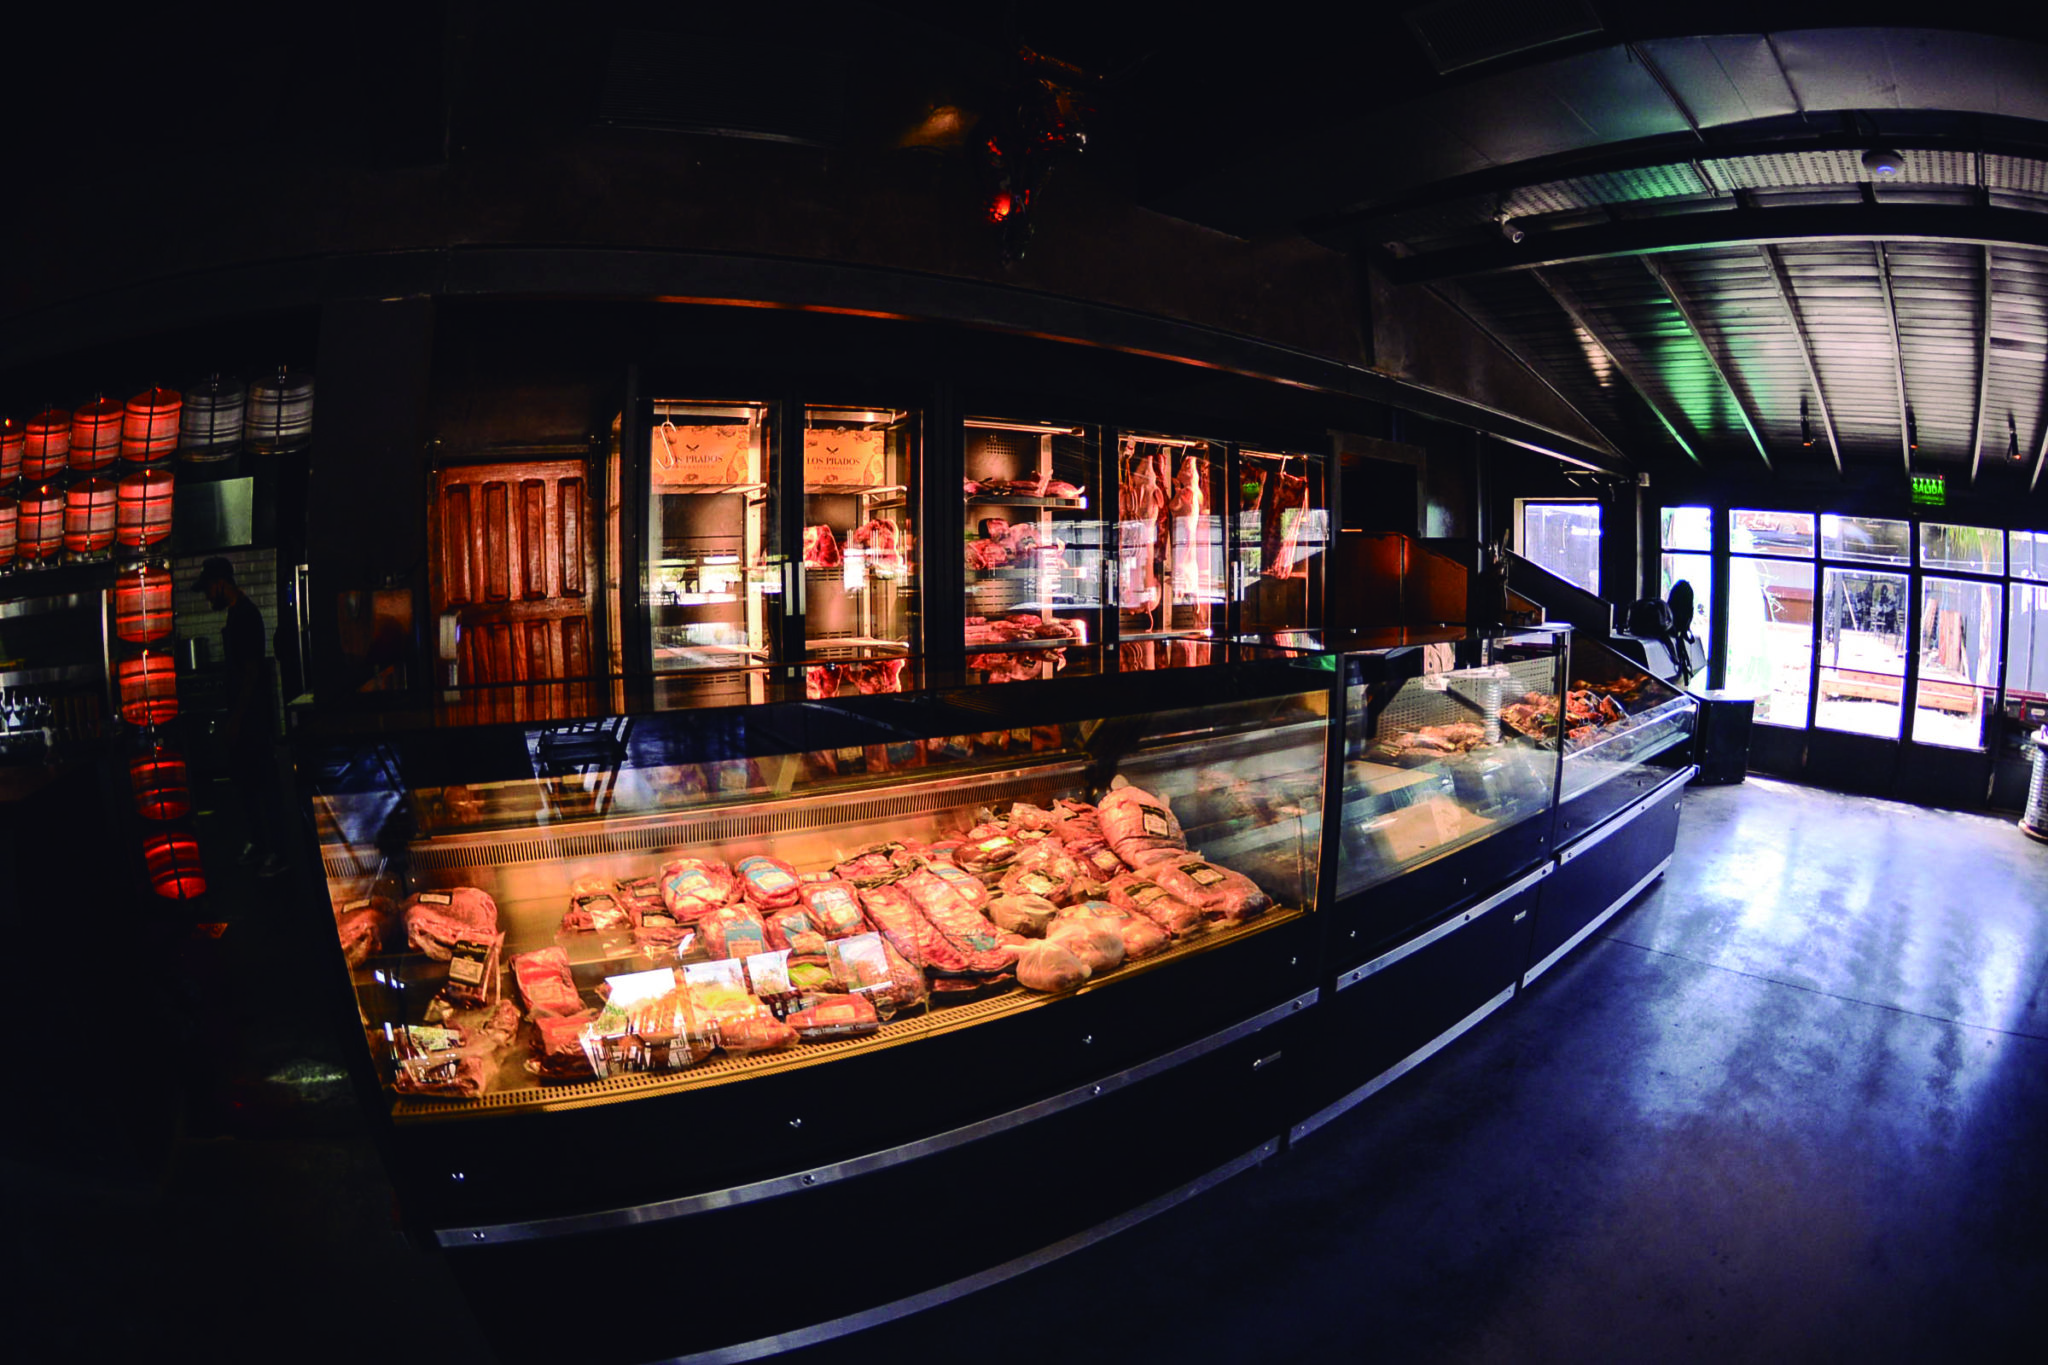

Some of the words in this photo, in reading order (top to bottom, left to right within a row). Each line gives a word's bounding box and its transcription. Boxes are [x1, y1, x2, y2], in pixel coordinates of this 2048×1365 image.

[686, 455, 723, 464] PRADOS
[806, 456, 824, 465] LOS
[826, 456, 860, 466] PRADOS
[1912, 483, 1944, 495] SALIDA
